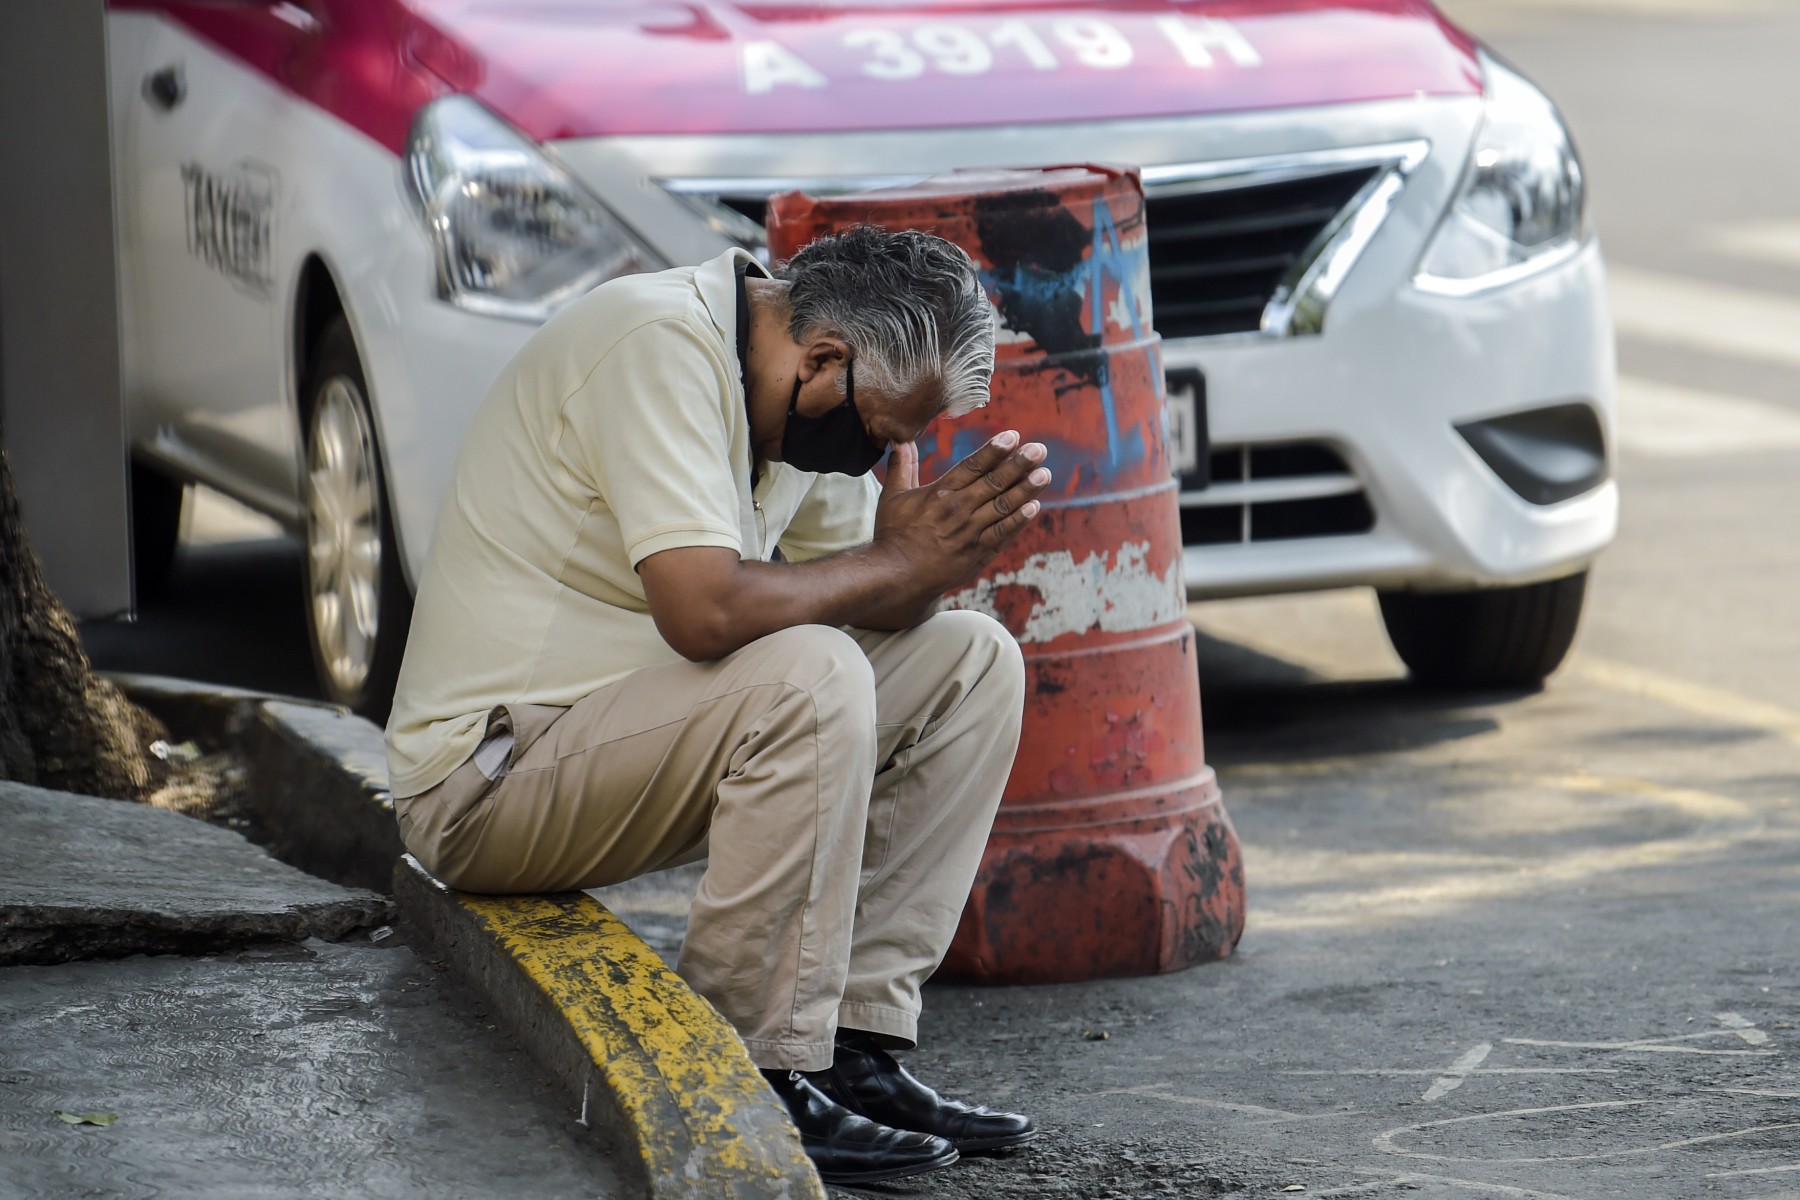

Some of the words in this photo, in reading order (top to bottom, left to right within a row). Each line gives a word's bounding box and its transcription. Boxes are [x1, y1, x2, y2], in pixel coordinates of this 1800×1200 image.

[742, 39, 829, 95] A
[841, 18, 1134, 80] 3919
[1153, 14, 1263, 69] H
